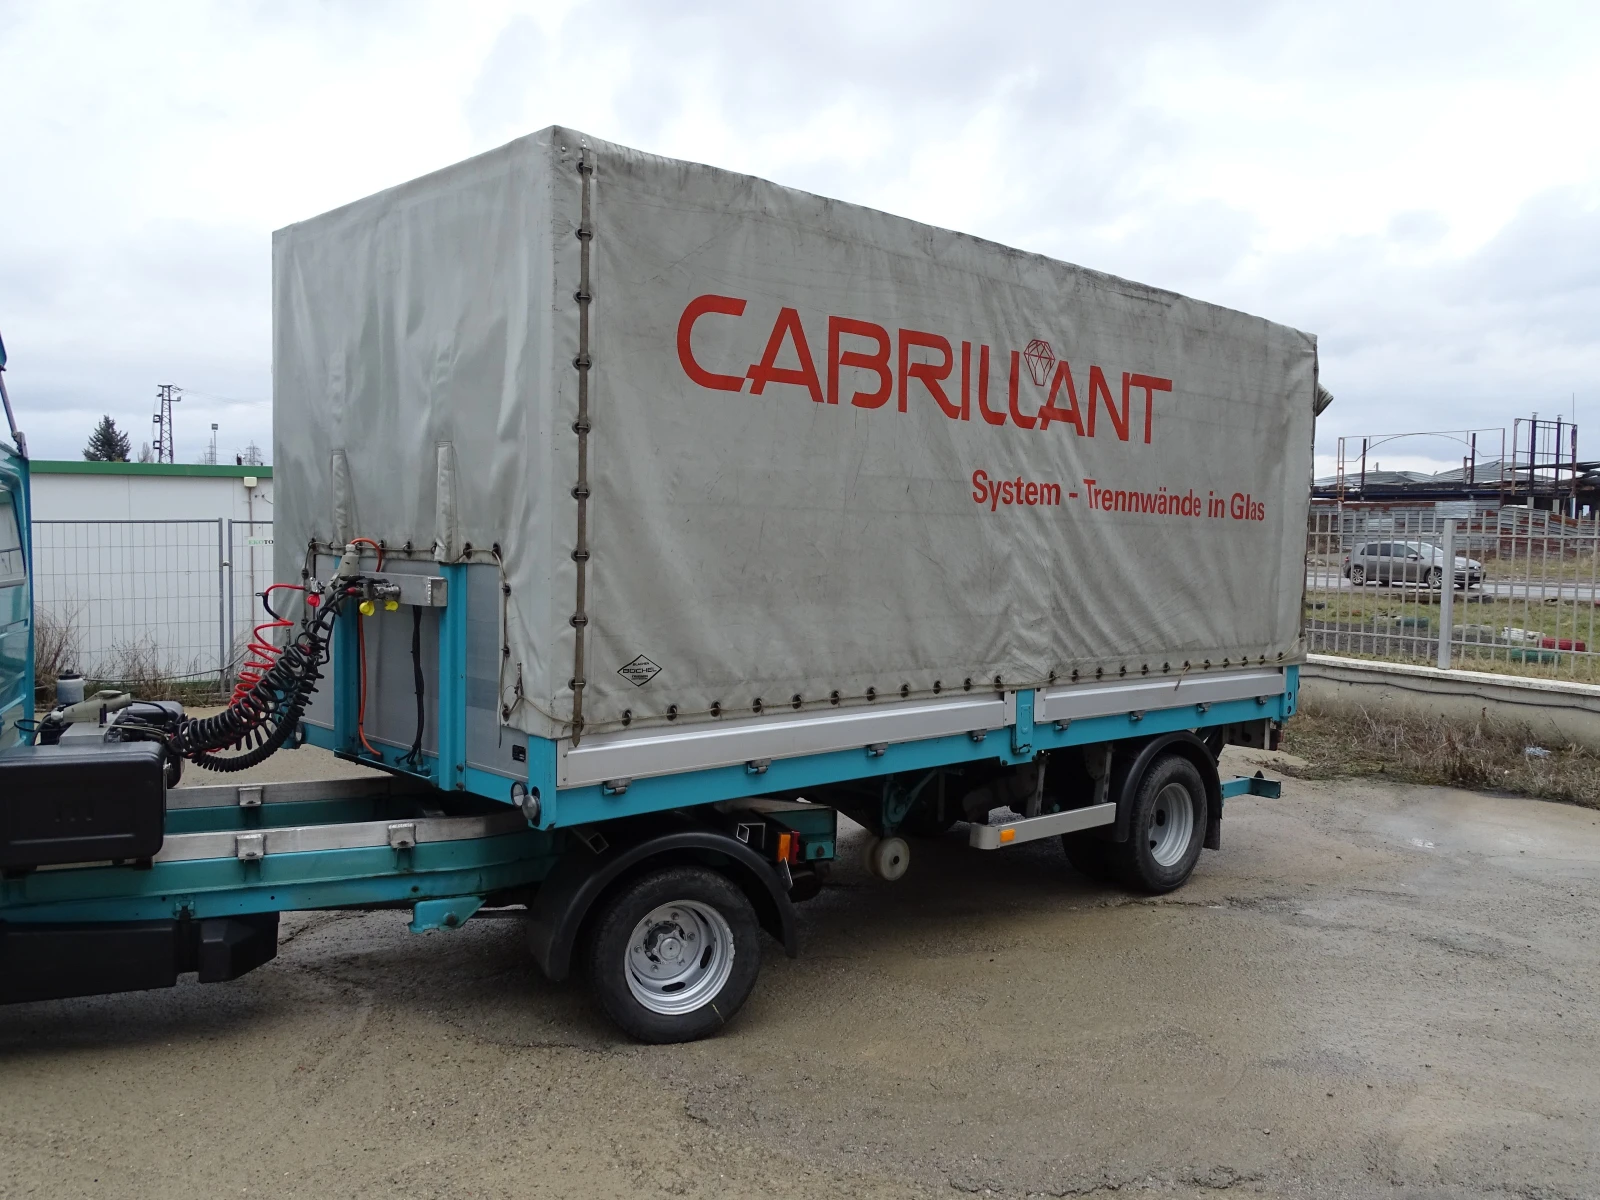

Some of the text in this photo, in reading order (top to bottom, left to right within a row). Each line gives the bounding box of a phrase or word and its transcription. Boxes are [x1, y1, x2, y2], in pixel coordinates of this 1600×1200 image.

[676, 294, 1173, 444] CABRILLANT
[972, 469, 1061, 512] System
[1083, 478, 1201, 517] Trennwände
[1207, 490, 1225, 518] in
[1230, 492, 1265, 521] Glas
